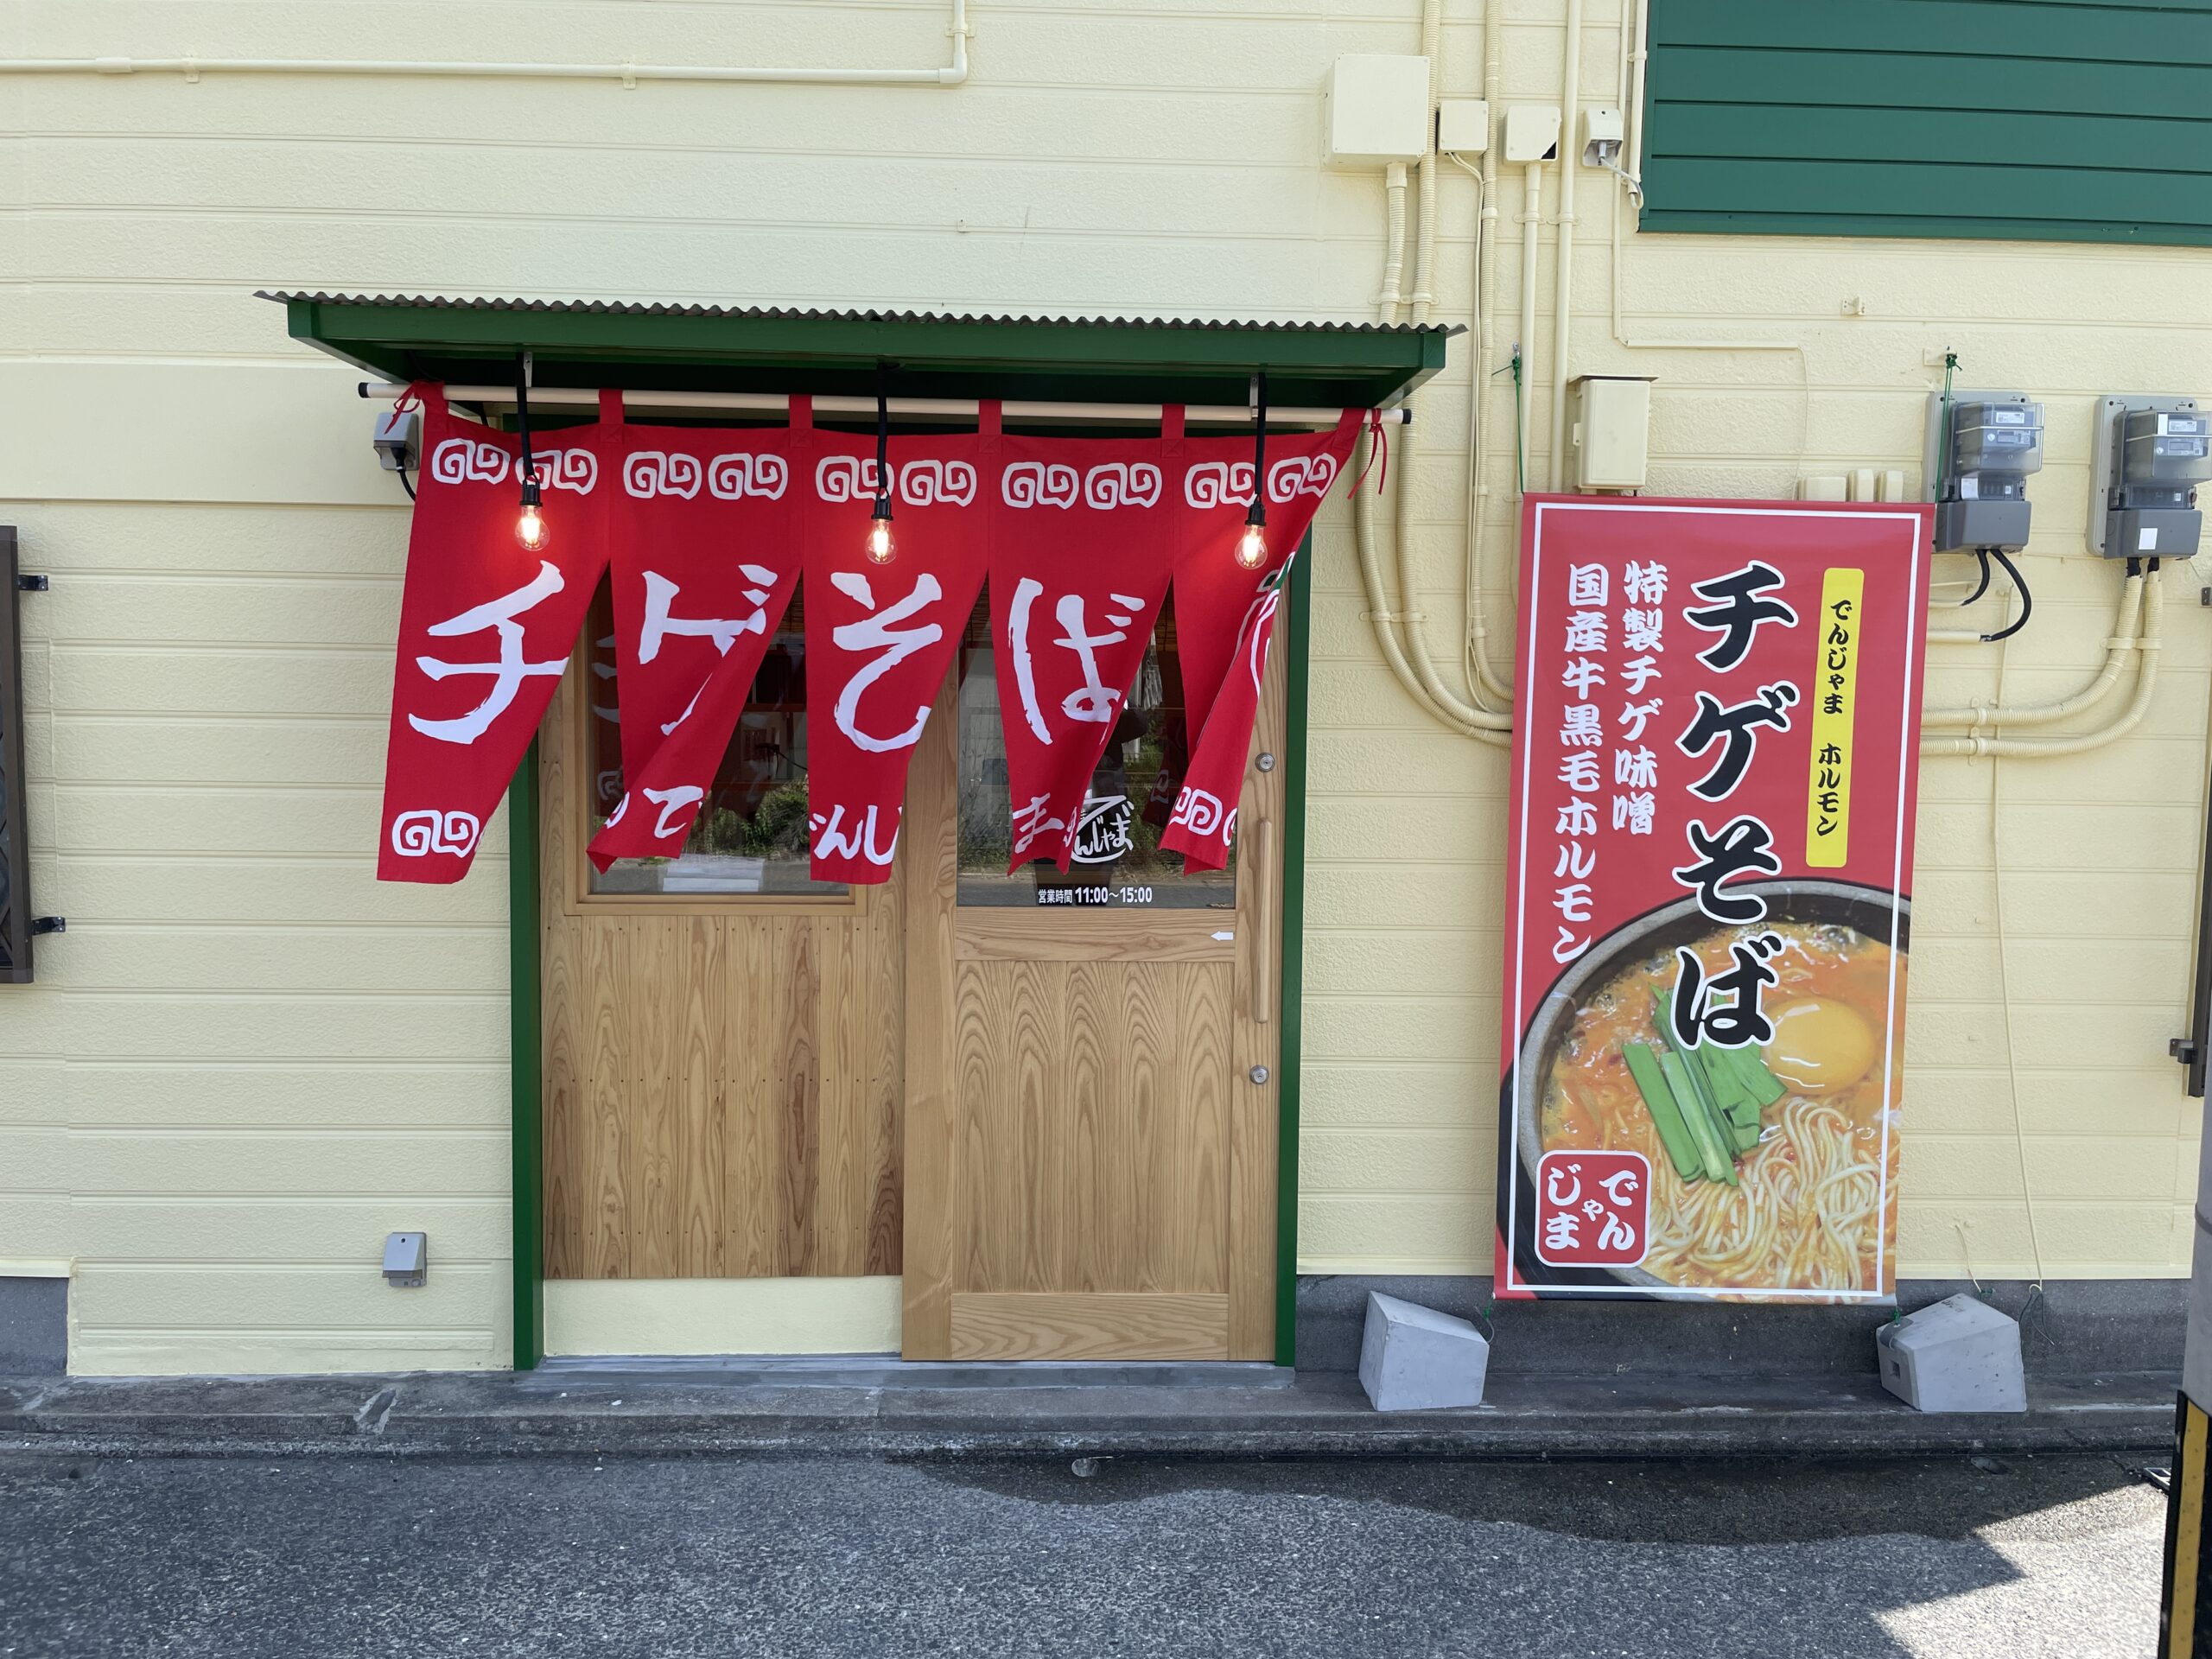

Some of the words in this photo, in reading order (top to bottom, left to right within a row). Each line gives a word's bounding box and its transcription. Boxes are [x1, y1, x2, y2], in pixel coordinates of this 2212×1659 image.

[1613, 561, 1669, 836] 特製チゲ味噌
[1823, 600, 1853, 715] でんじゃま
[1552, 563, 1609, 964] 国産牛黒毛ホルモン
[1674, 560, 1801, 1051] チゲそば
[1816, 743, 1842, 837] ホルモン
[1038, 890, 1073, 904] 営業時間
